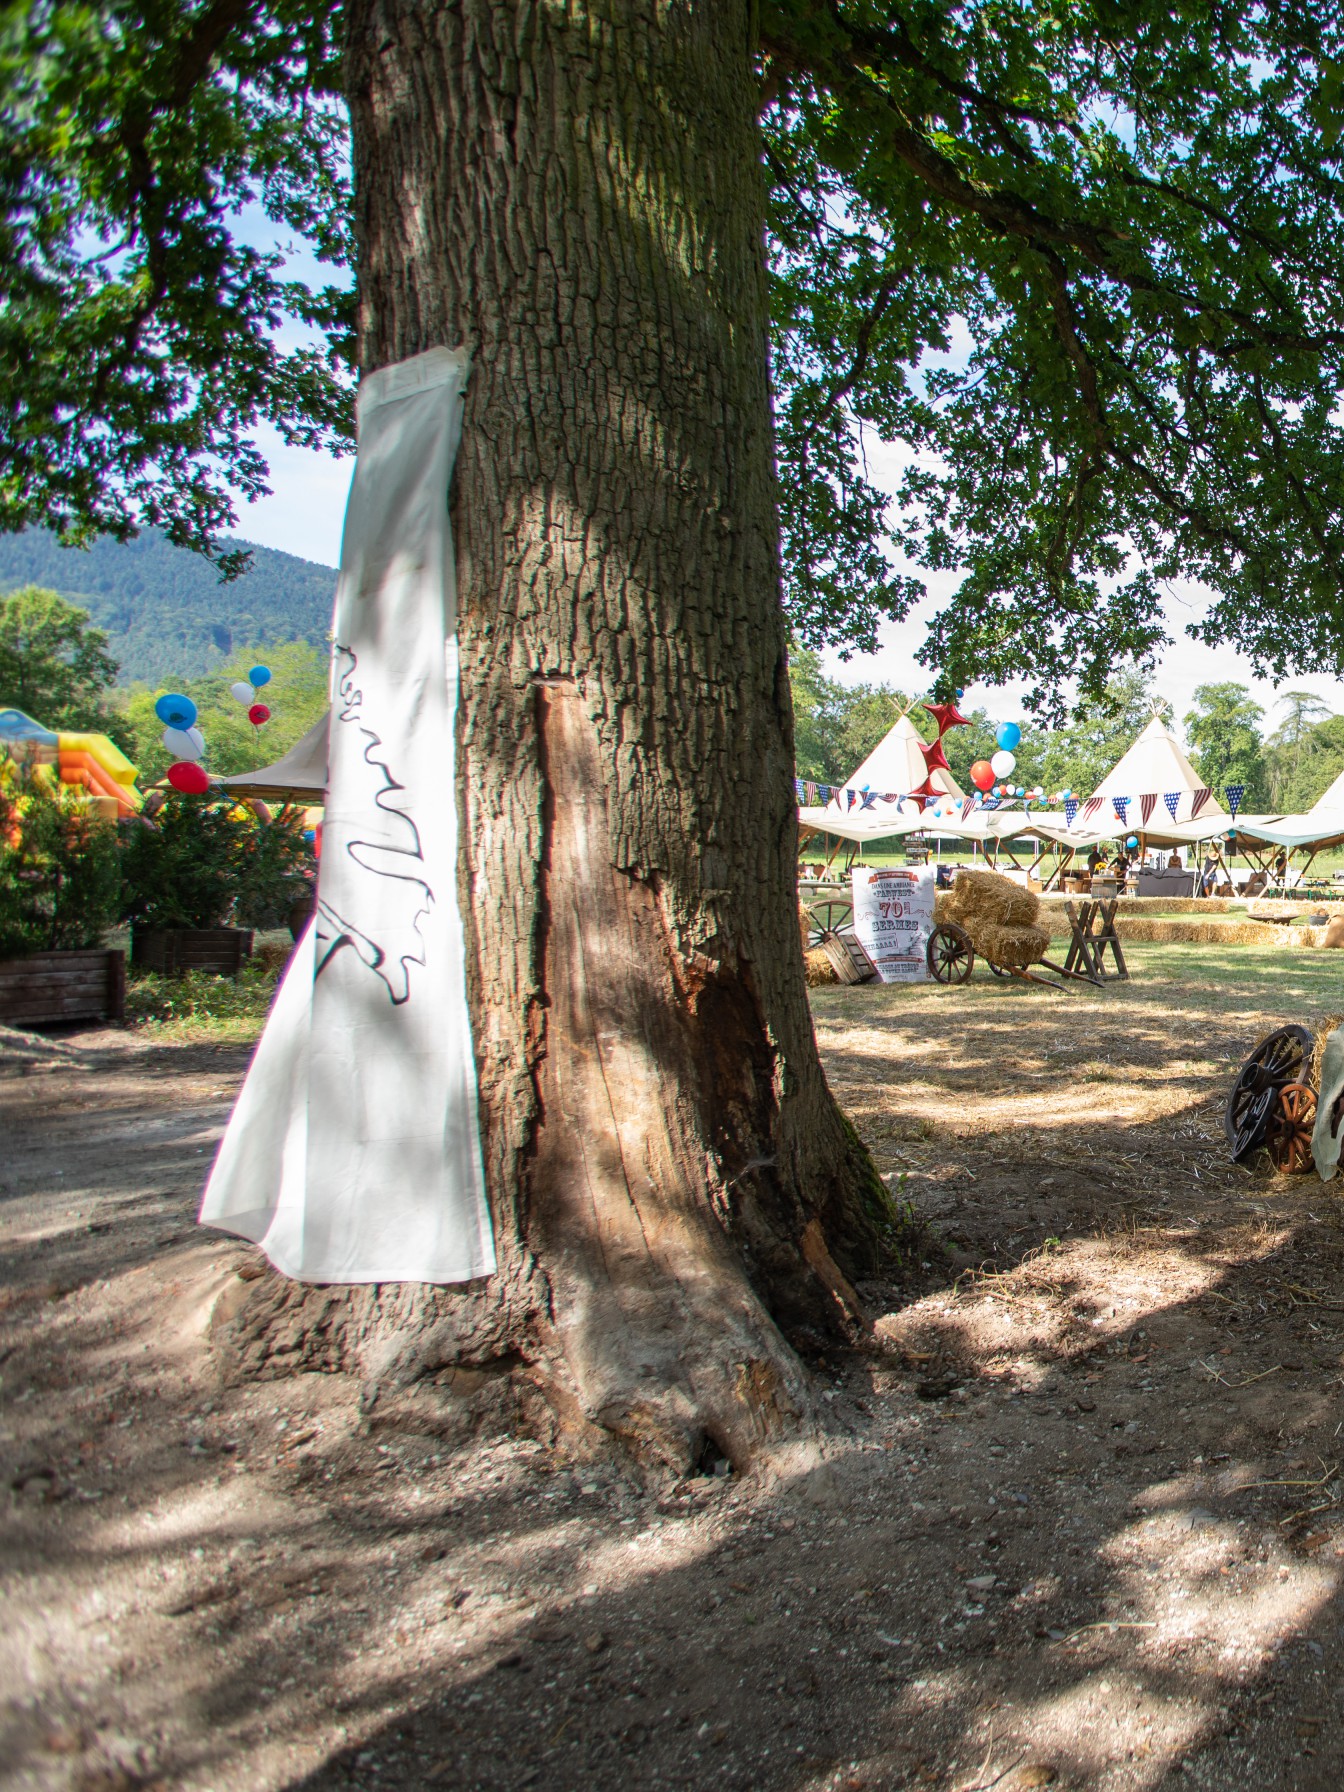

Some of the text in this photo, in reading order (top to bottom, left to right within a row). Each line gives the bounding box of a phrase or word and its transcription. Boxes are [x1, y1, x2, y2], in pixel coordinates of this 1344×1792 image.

[893, 881, 914, 889] AMBIANCE
[879, 902, 903, 918] 70
[872, 920, 919, 931] SERMES
